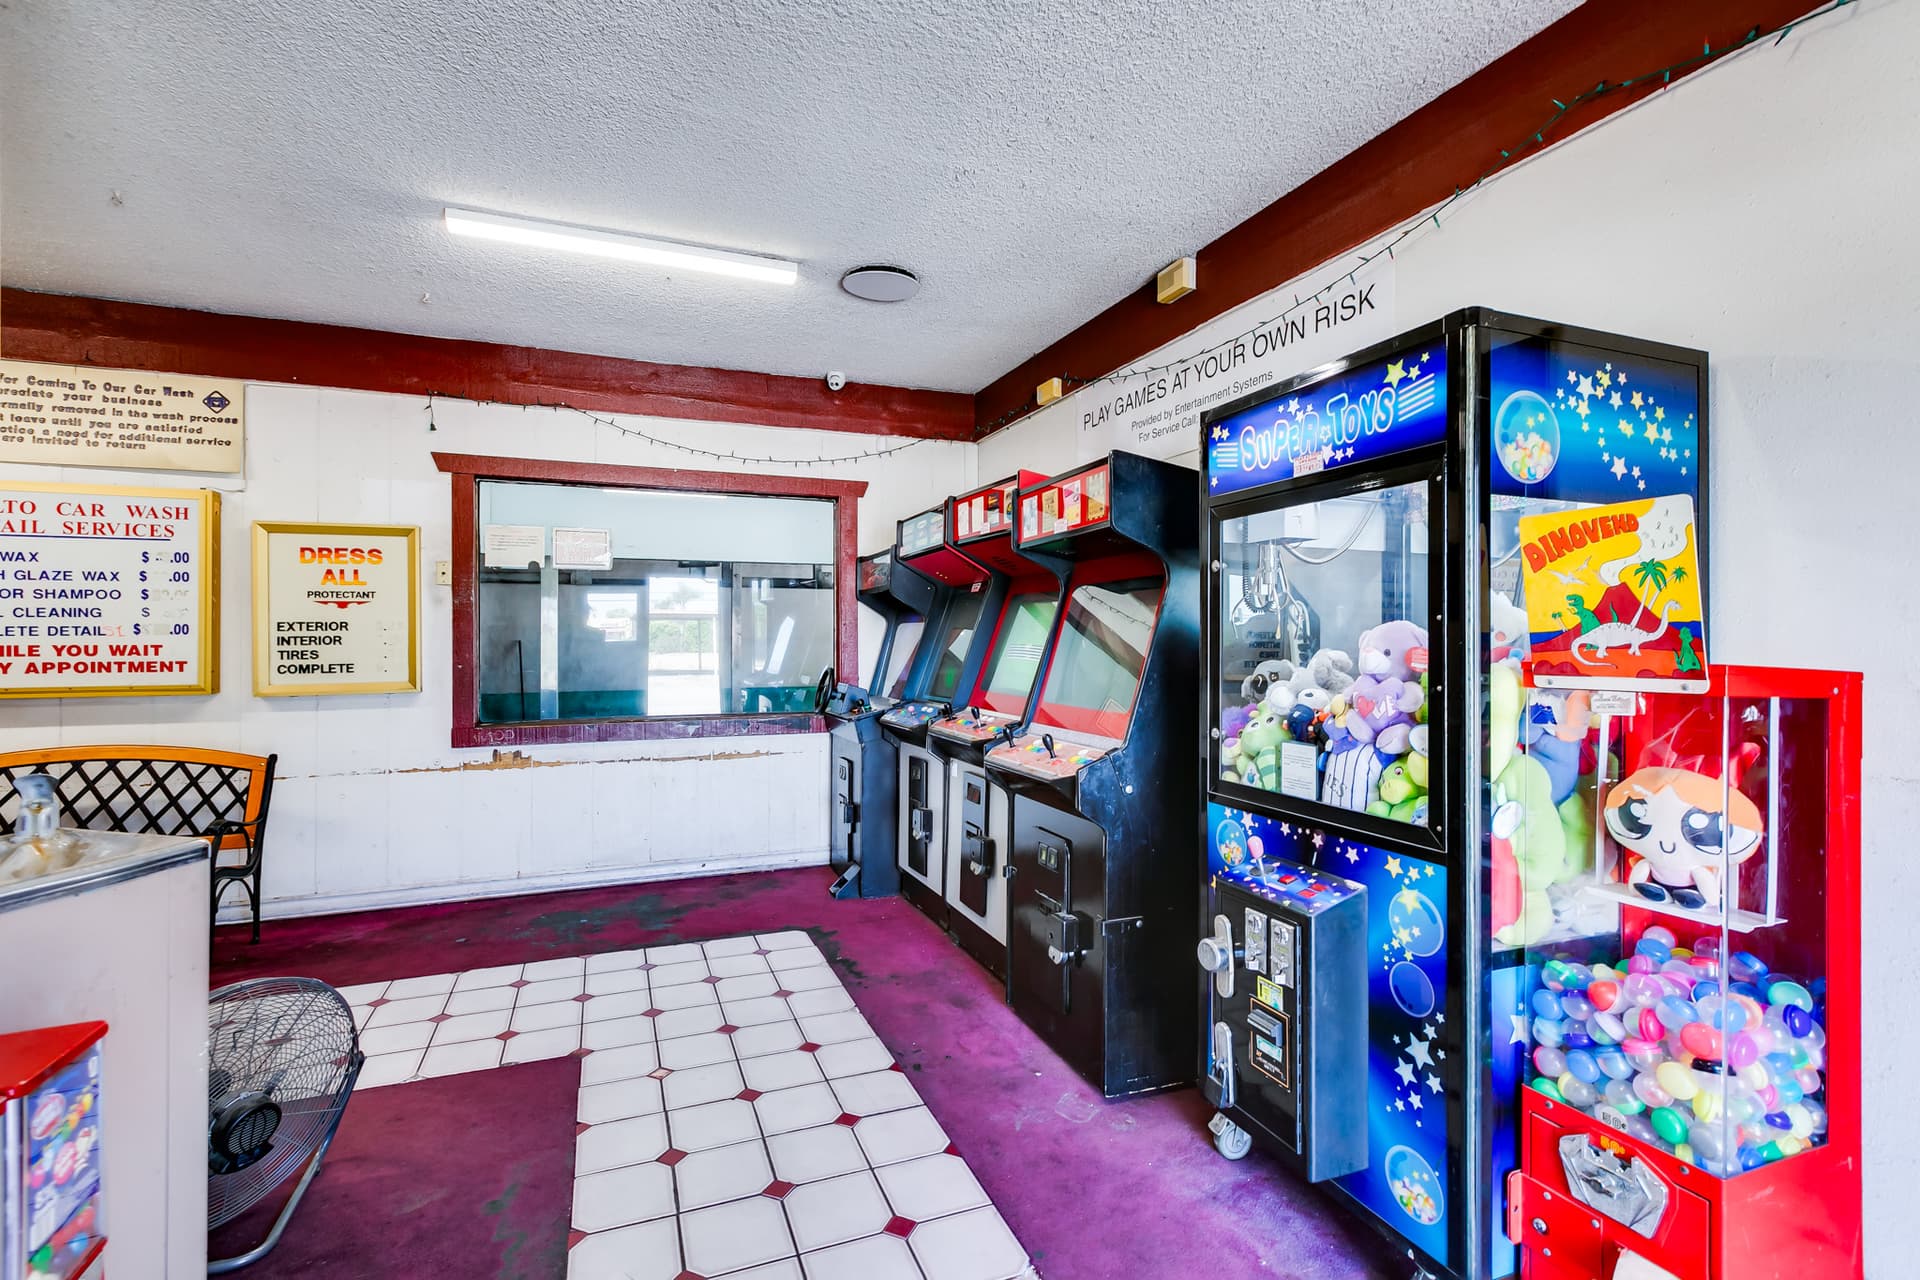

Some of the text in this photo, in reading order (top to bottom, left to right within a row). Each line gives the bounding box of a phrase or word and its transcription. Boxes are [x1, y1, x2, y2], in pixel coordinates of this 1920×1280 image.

[1084, 283, 1376, 431] PLAY GAMES AT YOUR OWN RISK
[27, 375, 76, 391] Coming
[82, 380, 97, 390] To
[103, 382, 126, 393] Our
[134, 384, 156, 395] Car
[163, 386, 194, 398] Wash
[63, 393, 93, 402] your
[102, 395, 162, 407] business
[1131, 371, 1273, 431] Provided by Entertainment Systems
[52, 405, 106, 416] removed
[112, 408, 123, 416] in
[128, 409, 148, 418] the
[152, 413, 183, 421] wash
[190, 415, 238, 424] process
[10, 414, 46, 423] leave
[52, 417, 82, 427] until
[89, 420, 112, 429] you
[145, 424, 203, 434] satisfied
[1138, 432, 1150, 443] For
[1152, 421, 1180, 438] Service
[2, 434, 146, 450] are invited to return
[57, 430, 88, 438] need
[94, 431, 113, 440] for
[118, 433, 181, 444] additional
[186, 437, 231, 447] service
[56, 502, 105, 517] CAR
[126, 505, 189, 520] WASH
[63, 521, 175, 538] SERVICES
[1523, 514, 1639, 573] DINOVEND
[0, 551, 39, 562] WAX
[299, 547, 383, 565] DRESS
[14, 570, 73, 581] GLAZE
[82, 571, 120, 582] WAX
[321, 569, 368, 586] ALL
[33, 588, 122, 600] SHAMPOO
[307, 591, 376, 599] PROTECTANT
[13, 607, 102, 618] CLEANING
[277, 621, 349, 632] EXTERIOR
[277, 635, 342, 646] INTERIOR
[52, 644, 99, 657] YOU
[108, 644, 163, 656] WAIT
[277, 650, 319, 660] TIRES
[24, 661, 188, 674] APPOINTMENT
[277, 663, 354, 675] COMPLETE
